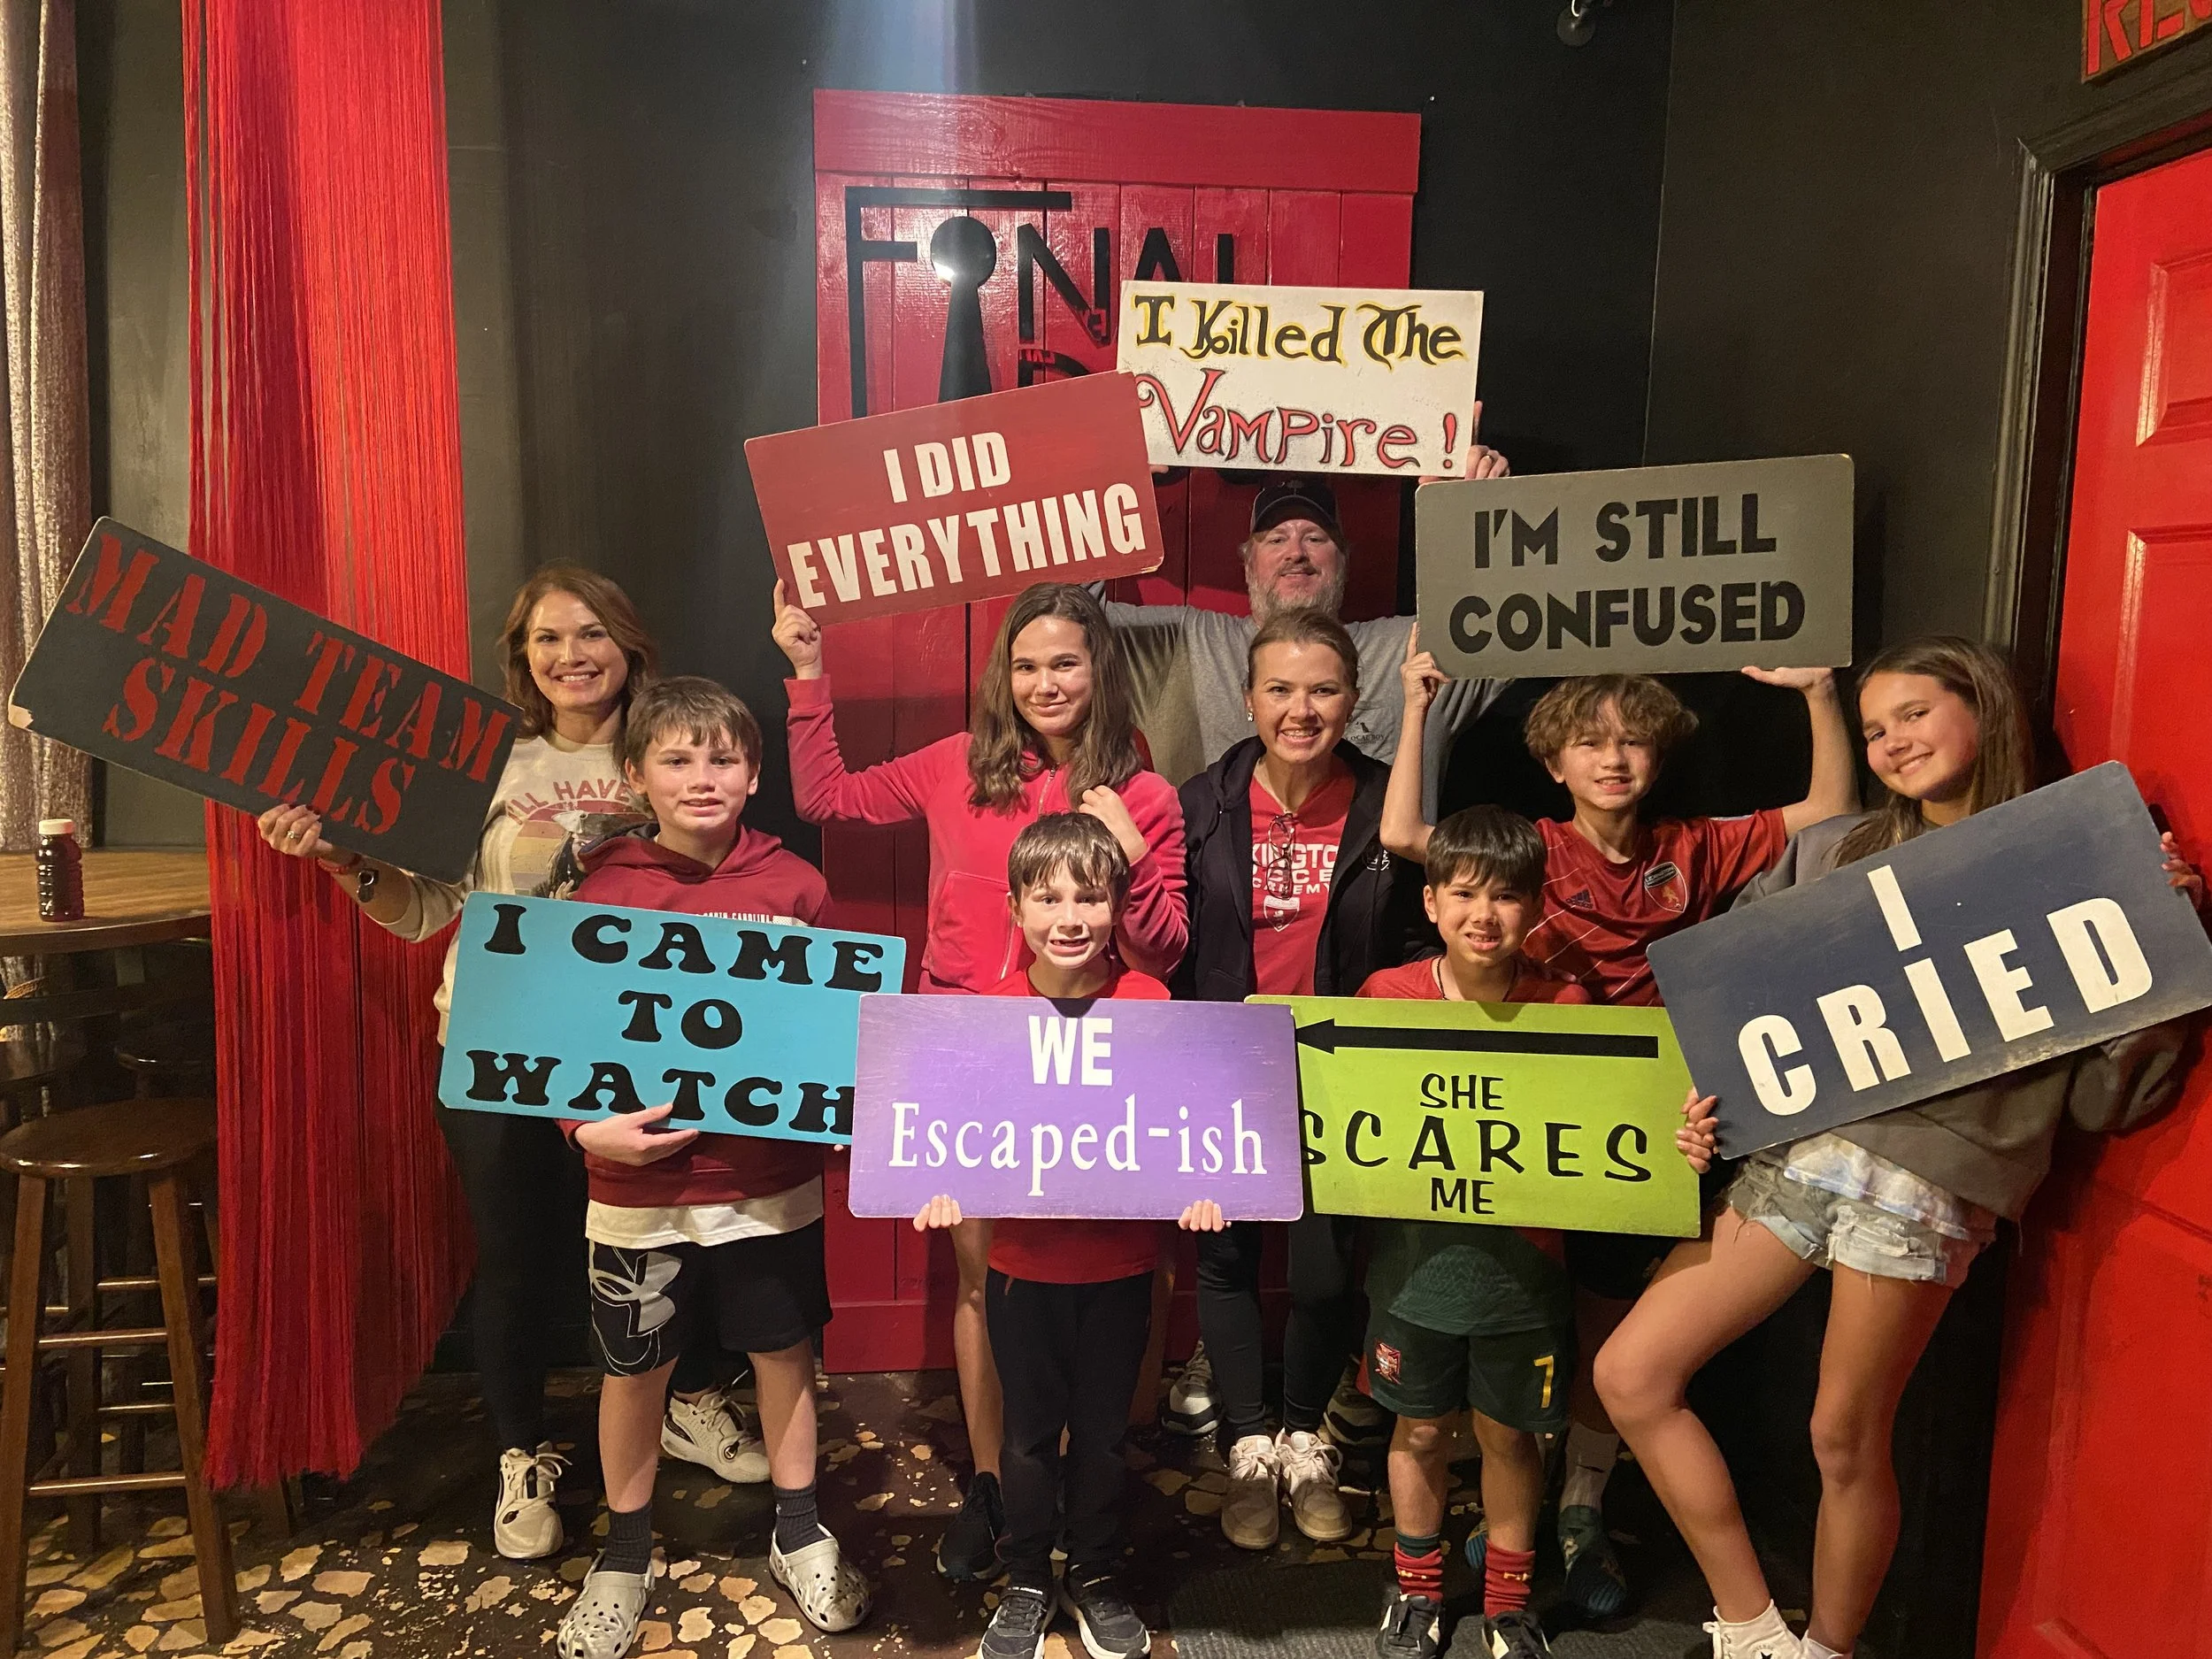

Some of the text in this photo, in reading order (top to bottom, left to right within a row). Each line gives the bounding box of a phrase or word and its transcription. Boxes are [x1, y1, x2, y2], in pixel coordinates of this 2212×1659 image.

[1134, 295, 1465, 370] I Killed The
[883, 432, 1011, 503] I DID
[787, 482, 1147, 609] EVERYTHING
[1475, 493, 1777, 569] I'M STILL
[1448, 580, 1806, 655] CONFUSED
[65, 533, 511, 783] MAD TEAM
[102, 657, 418, 835] SKILLS
[553, 779, 632, 803] HAVE
[1253, 864, 1333, 884] CCE
[1867, 864, 1923, 952] I
[484, 903, 885, 993] I CAME
[618, 989, 744, 1050] TO
[1738, 896, 2154, 1117] CRIED
[1028, 1015, 1114, 1087] WE
[465, 1050, 855, 1133] WATCH
[1420, 1072, 1505, 1111] SHE
[887, 1093, 1268, 1197] Escaped-ish
[1302, 1110, 1652, 1182] SCARES
[1432, 1178, 1495, 1215] ME
[1533, 1355, 1555, 1409] 7
